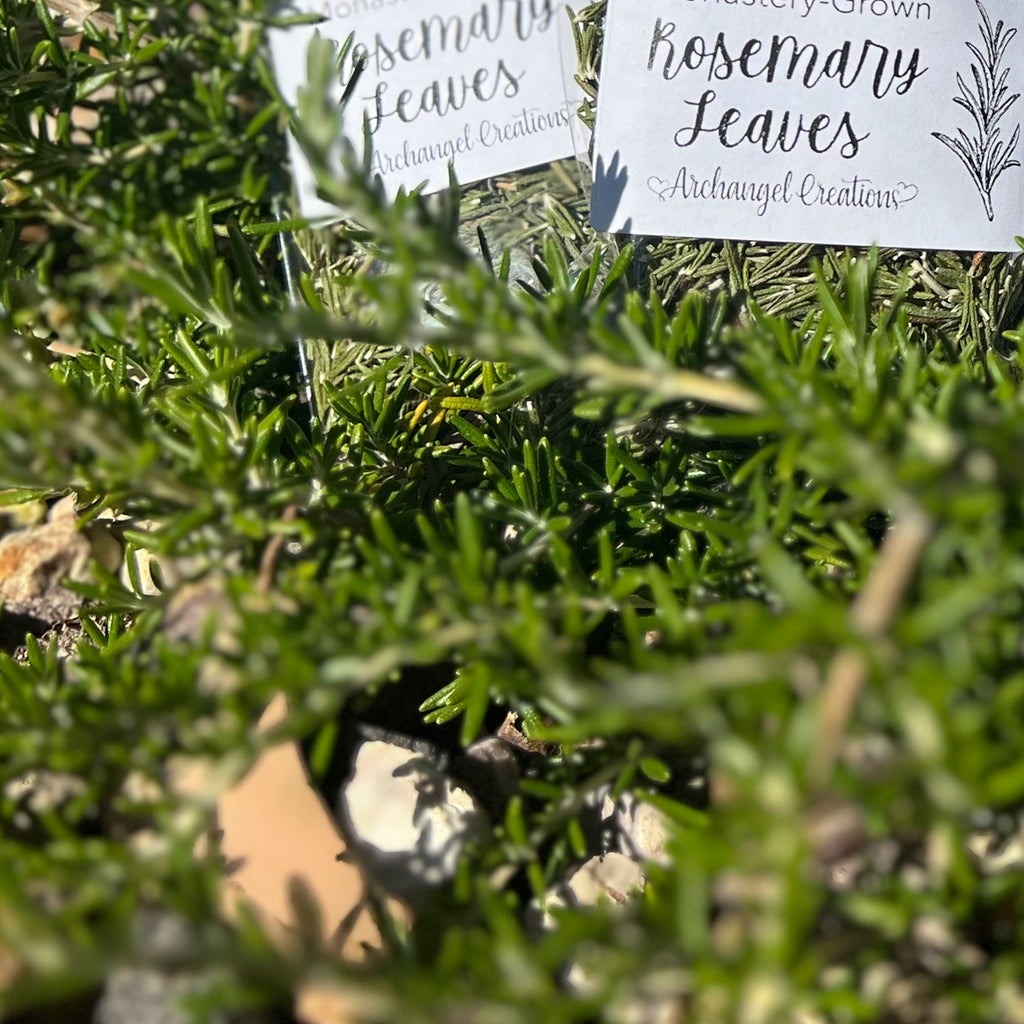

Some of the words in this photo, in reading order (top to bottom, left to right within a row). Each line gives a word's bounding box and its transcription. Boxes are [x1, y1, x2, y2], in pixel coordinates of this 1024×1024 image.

[646, 17, 929, 98] Rosemary
[362, 58, 526, 136] Leaves
[480, 107, 570, 147] Creations
[673, 89, 871, 159] Leaves
[666, 166, 794, 217] Archangel
[795, 173, 899, 210] Creations
